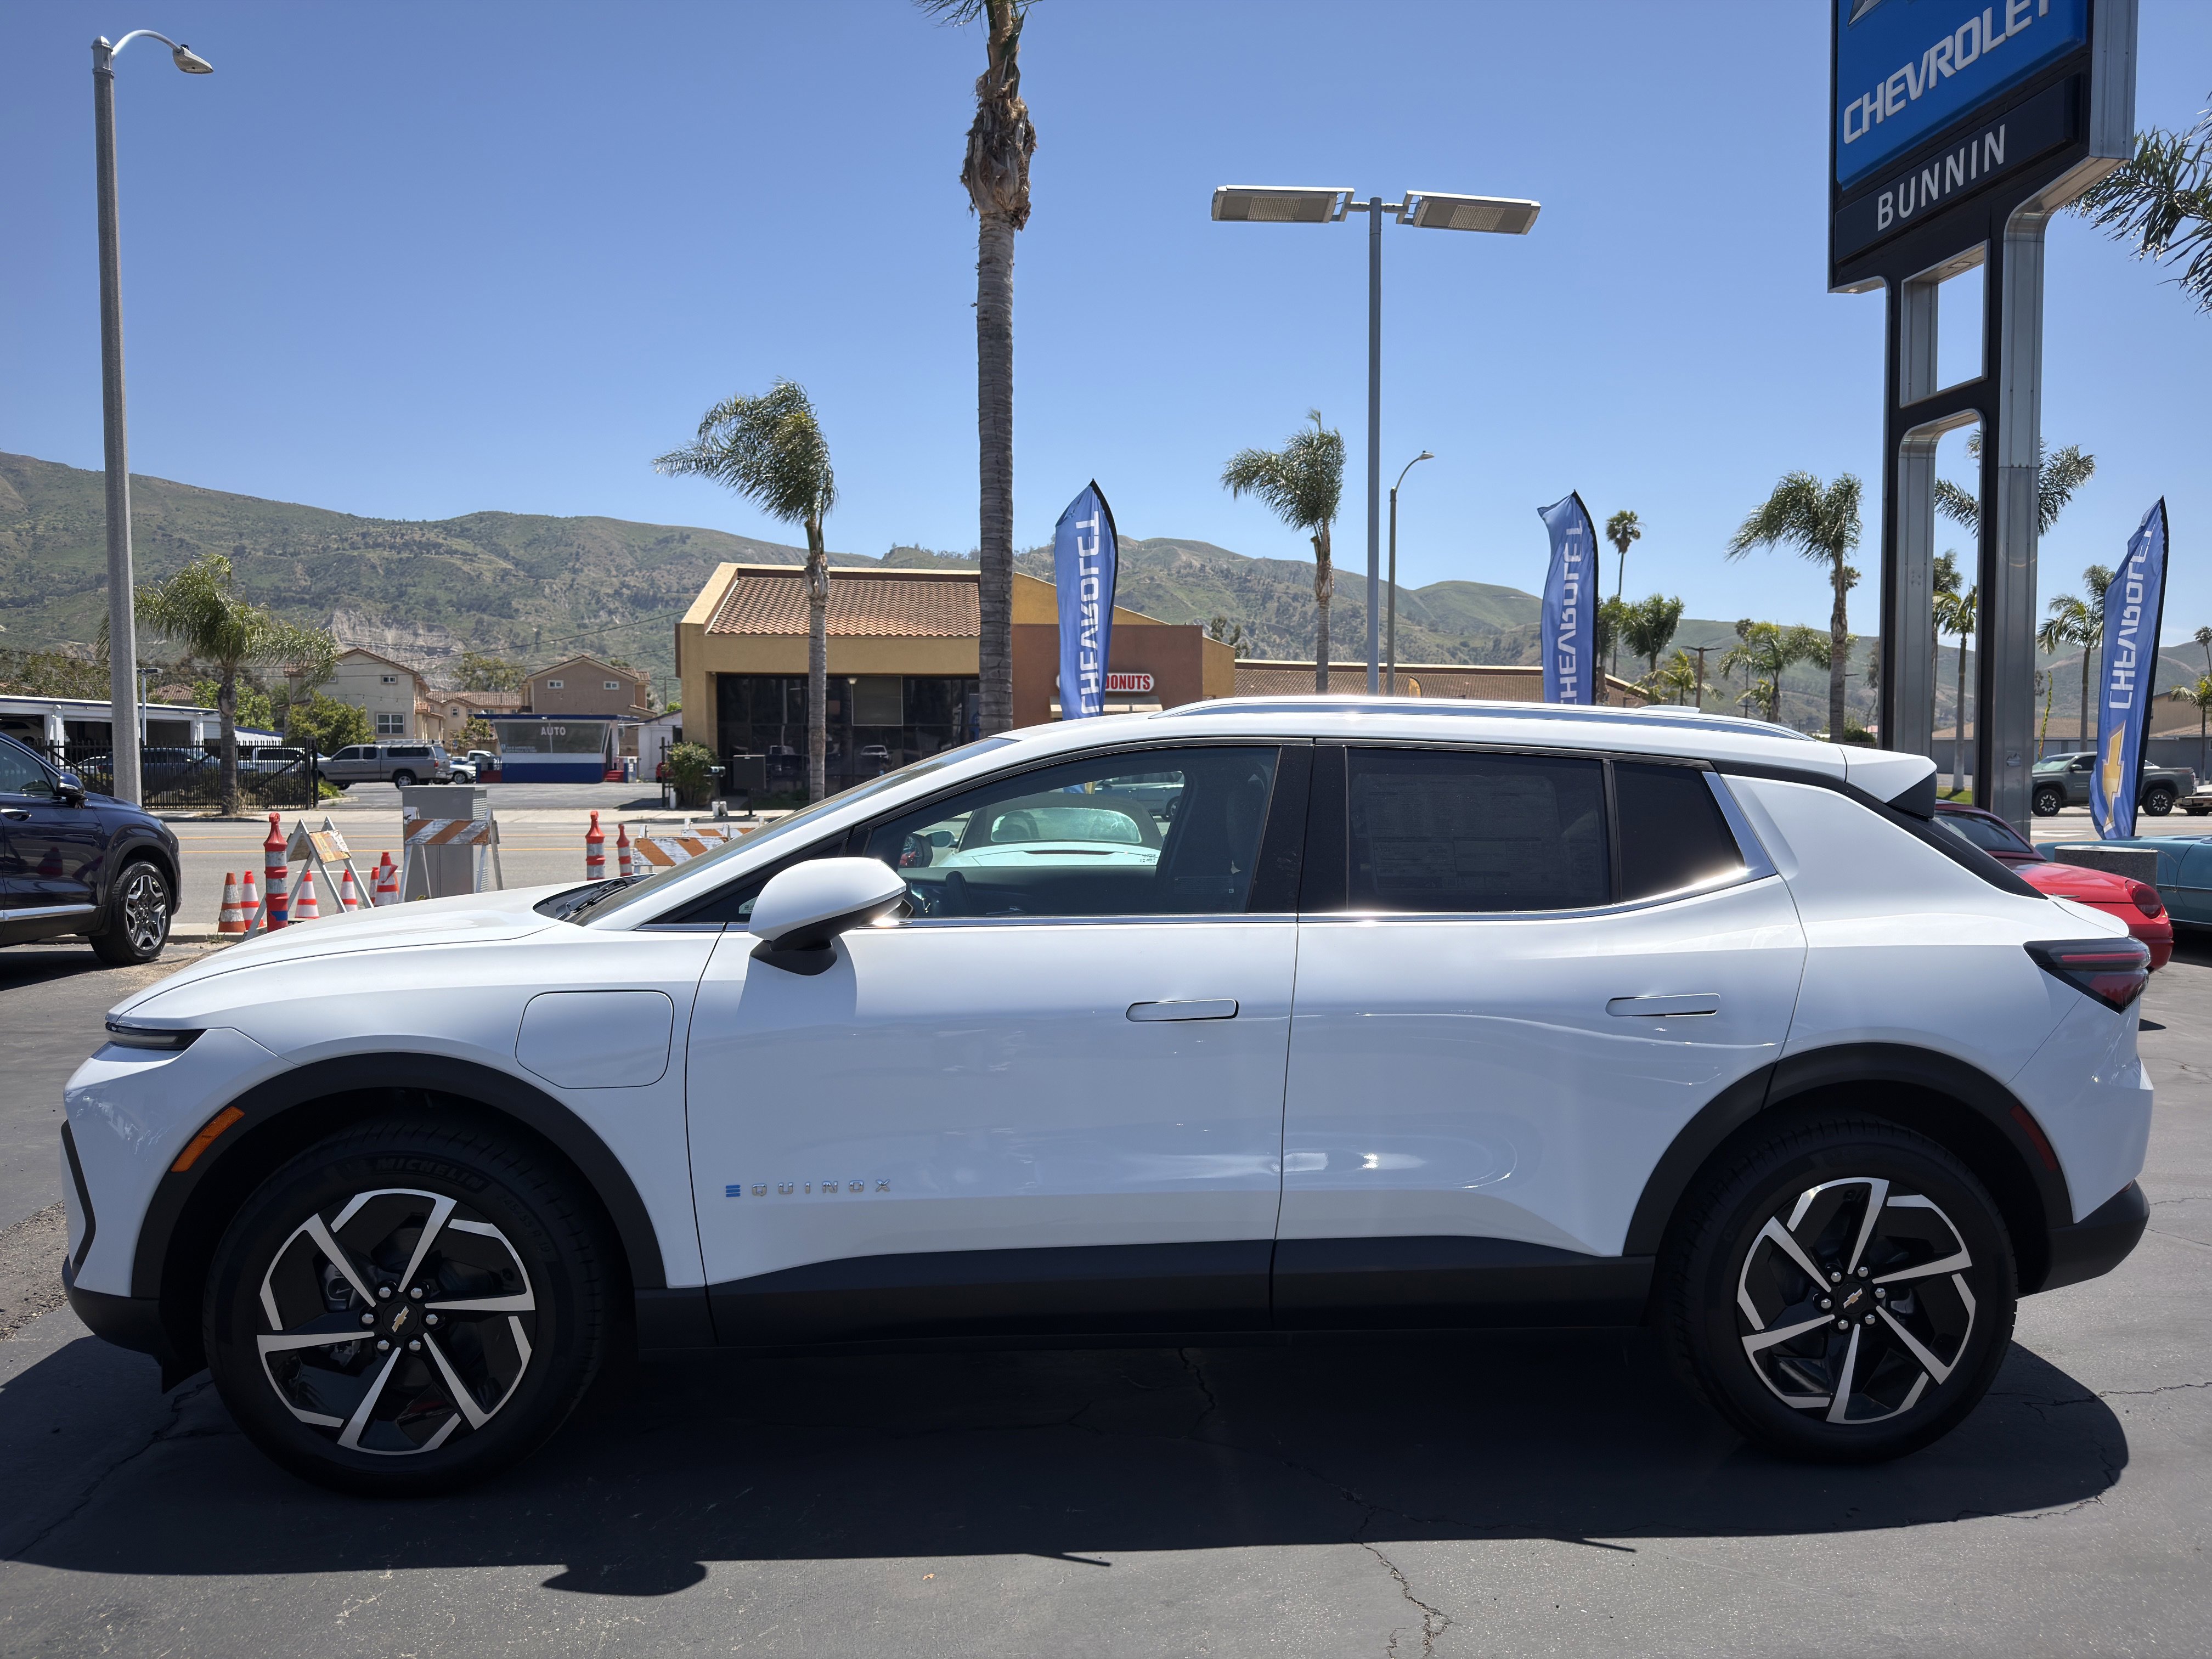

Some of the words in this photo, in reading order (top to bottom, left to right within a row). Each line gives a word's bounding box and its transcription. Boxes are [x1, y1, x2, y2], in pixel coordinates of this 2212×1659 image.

[1877, 124, 2006, 232] BUNNIN
[541, 726, 567, 736] AUTO
[376, 1157, 485, 1189] MICHELIN
[725, 1179, 891, 1198] EQUINOX
